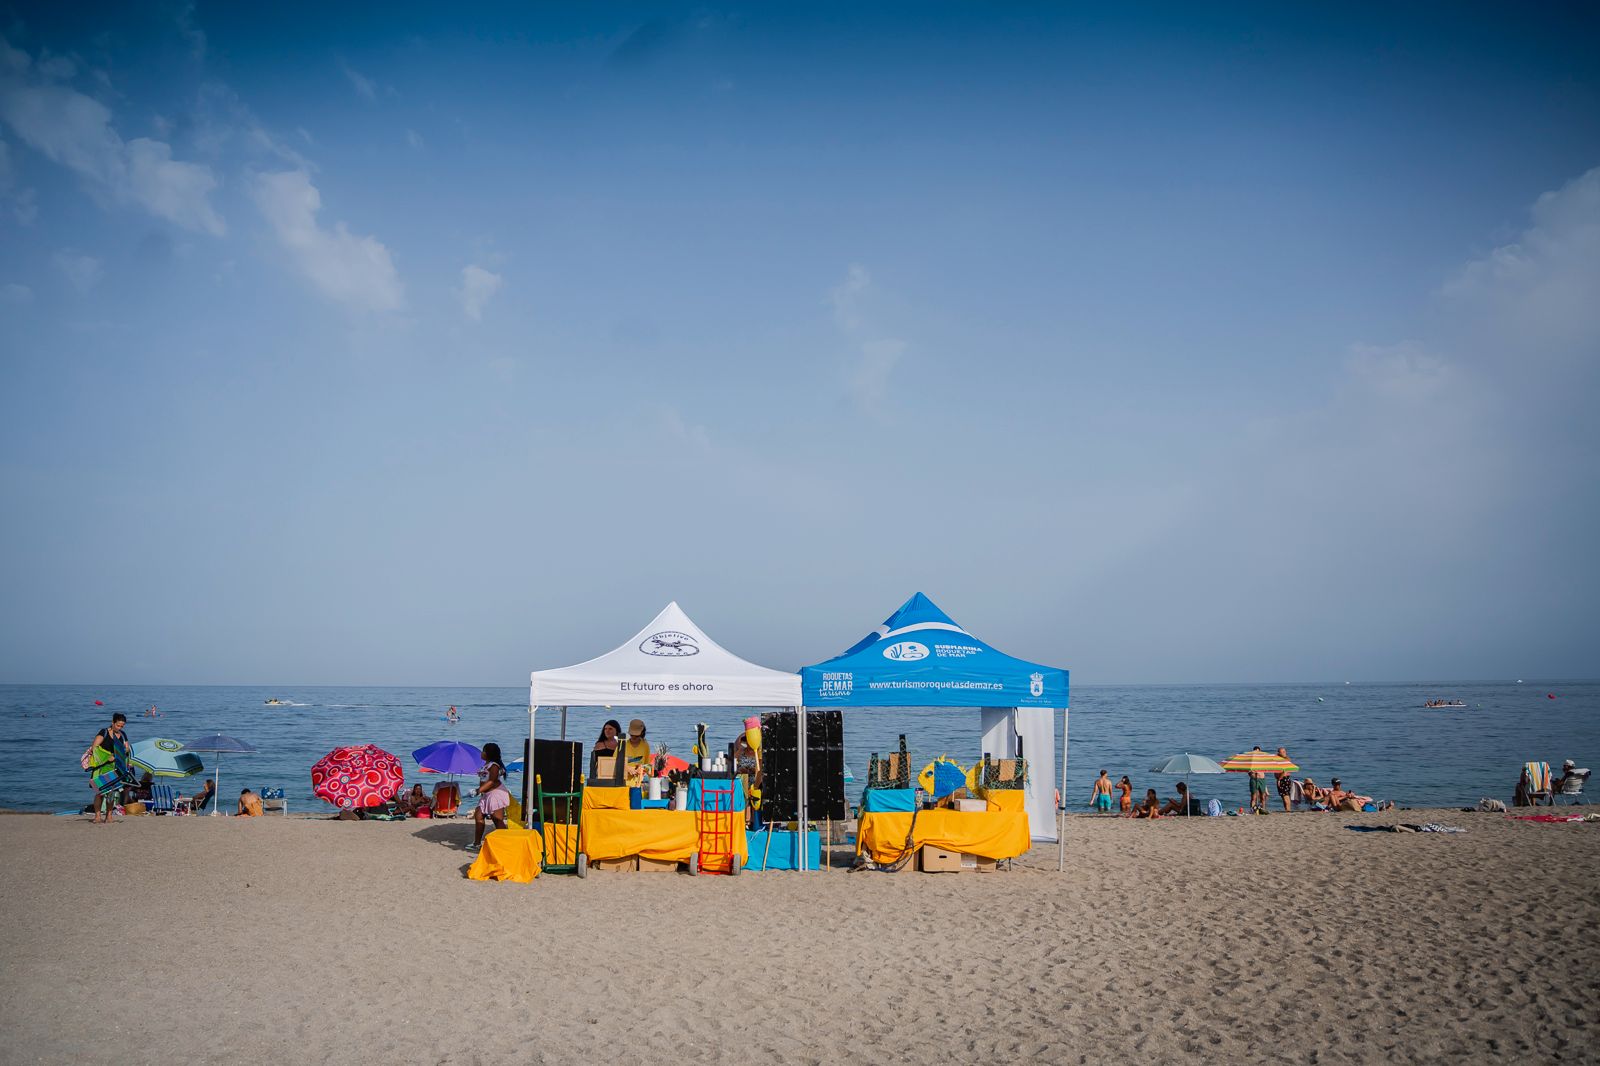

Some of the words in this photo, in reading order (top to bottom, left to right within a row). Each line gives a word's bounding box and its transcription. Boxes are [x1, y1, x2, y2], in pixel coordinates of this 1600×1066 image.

[823, 672, 853, 681] ROQUETAS
[620, 681, 631, 691] El
[633, 681, 665, 691] futuro
[668, 683, 680, 691] es
[682, 682, 713, 691] ahora
[869, 680, 1003, 690] www.turismoroquetasdemar.es
